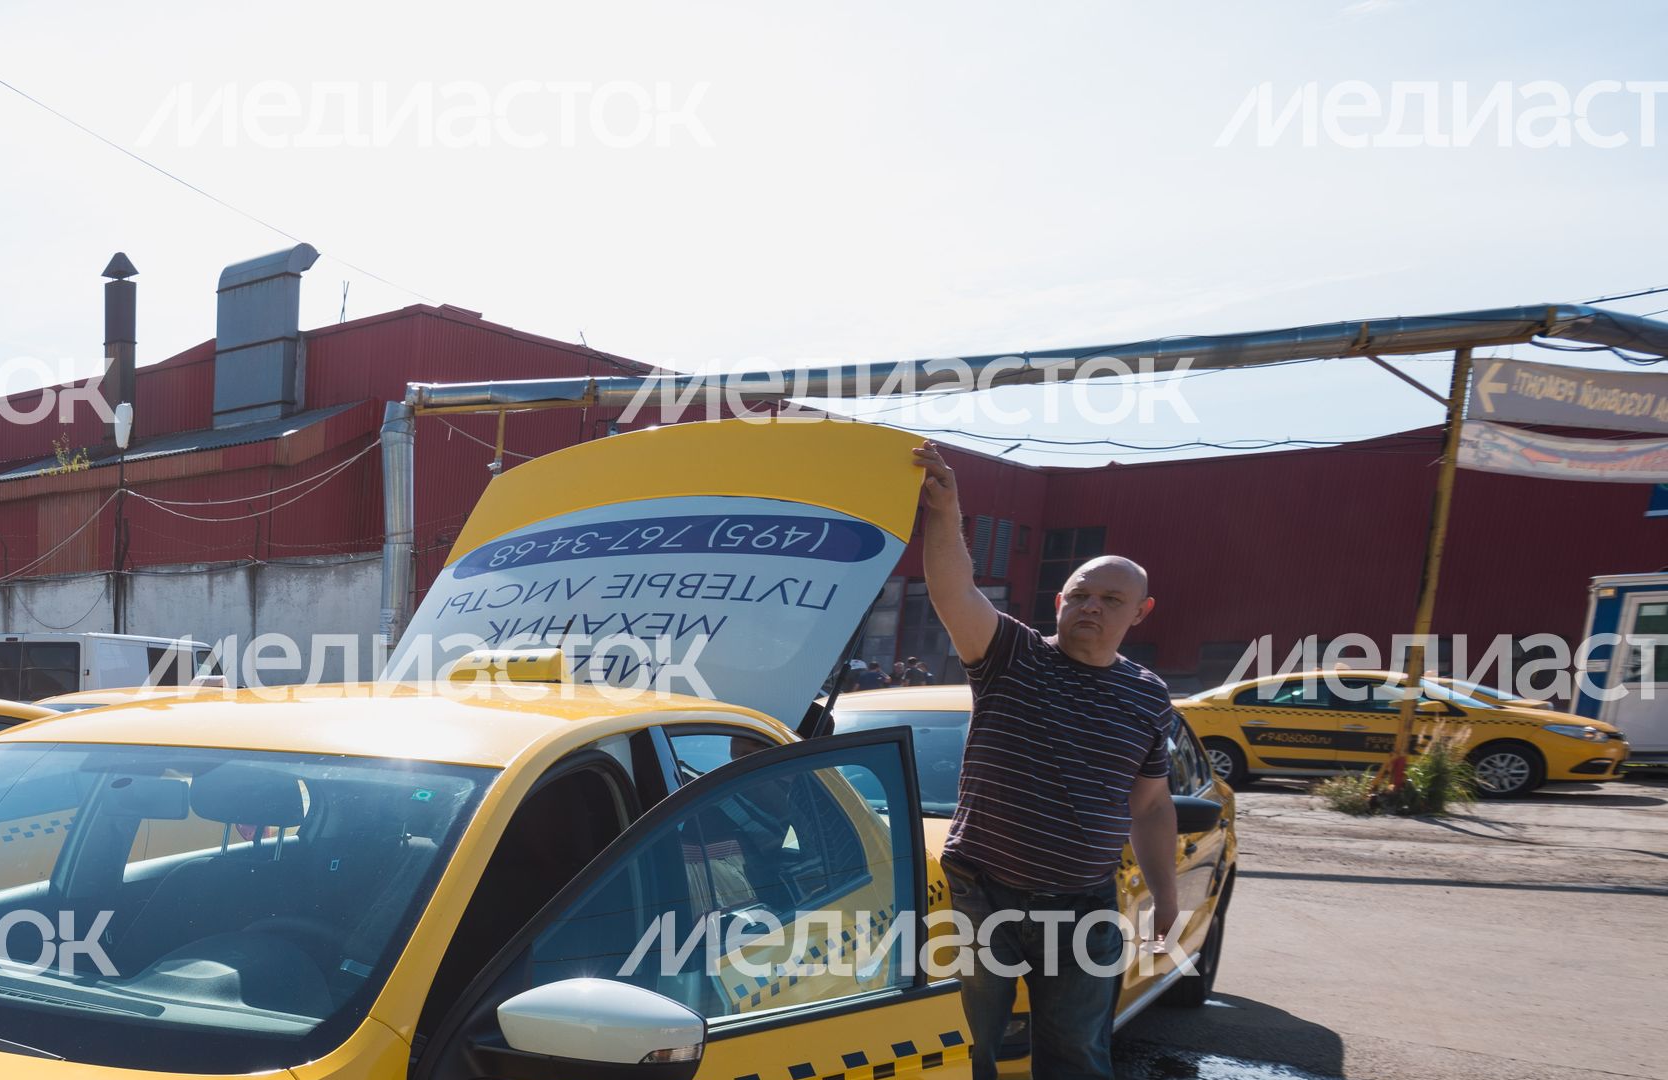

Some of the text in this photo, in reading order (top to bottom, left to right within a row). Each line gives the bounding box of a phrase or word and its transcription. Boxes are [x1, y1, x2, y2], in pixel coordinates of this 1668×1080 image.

[489, 518, 829, 567] (495) 767-34-68
[436, 573, 838, 620] ПУТЕВЫЕ ЛИСТЫ
[479, 612, 728, 645] МЕХАНИК
